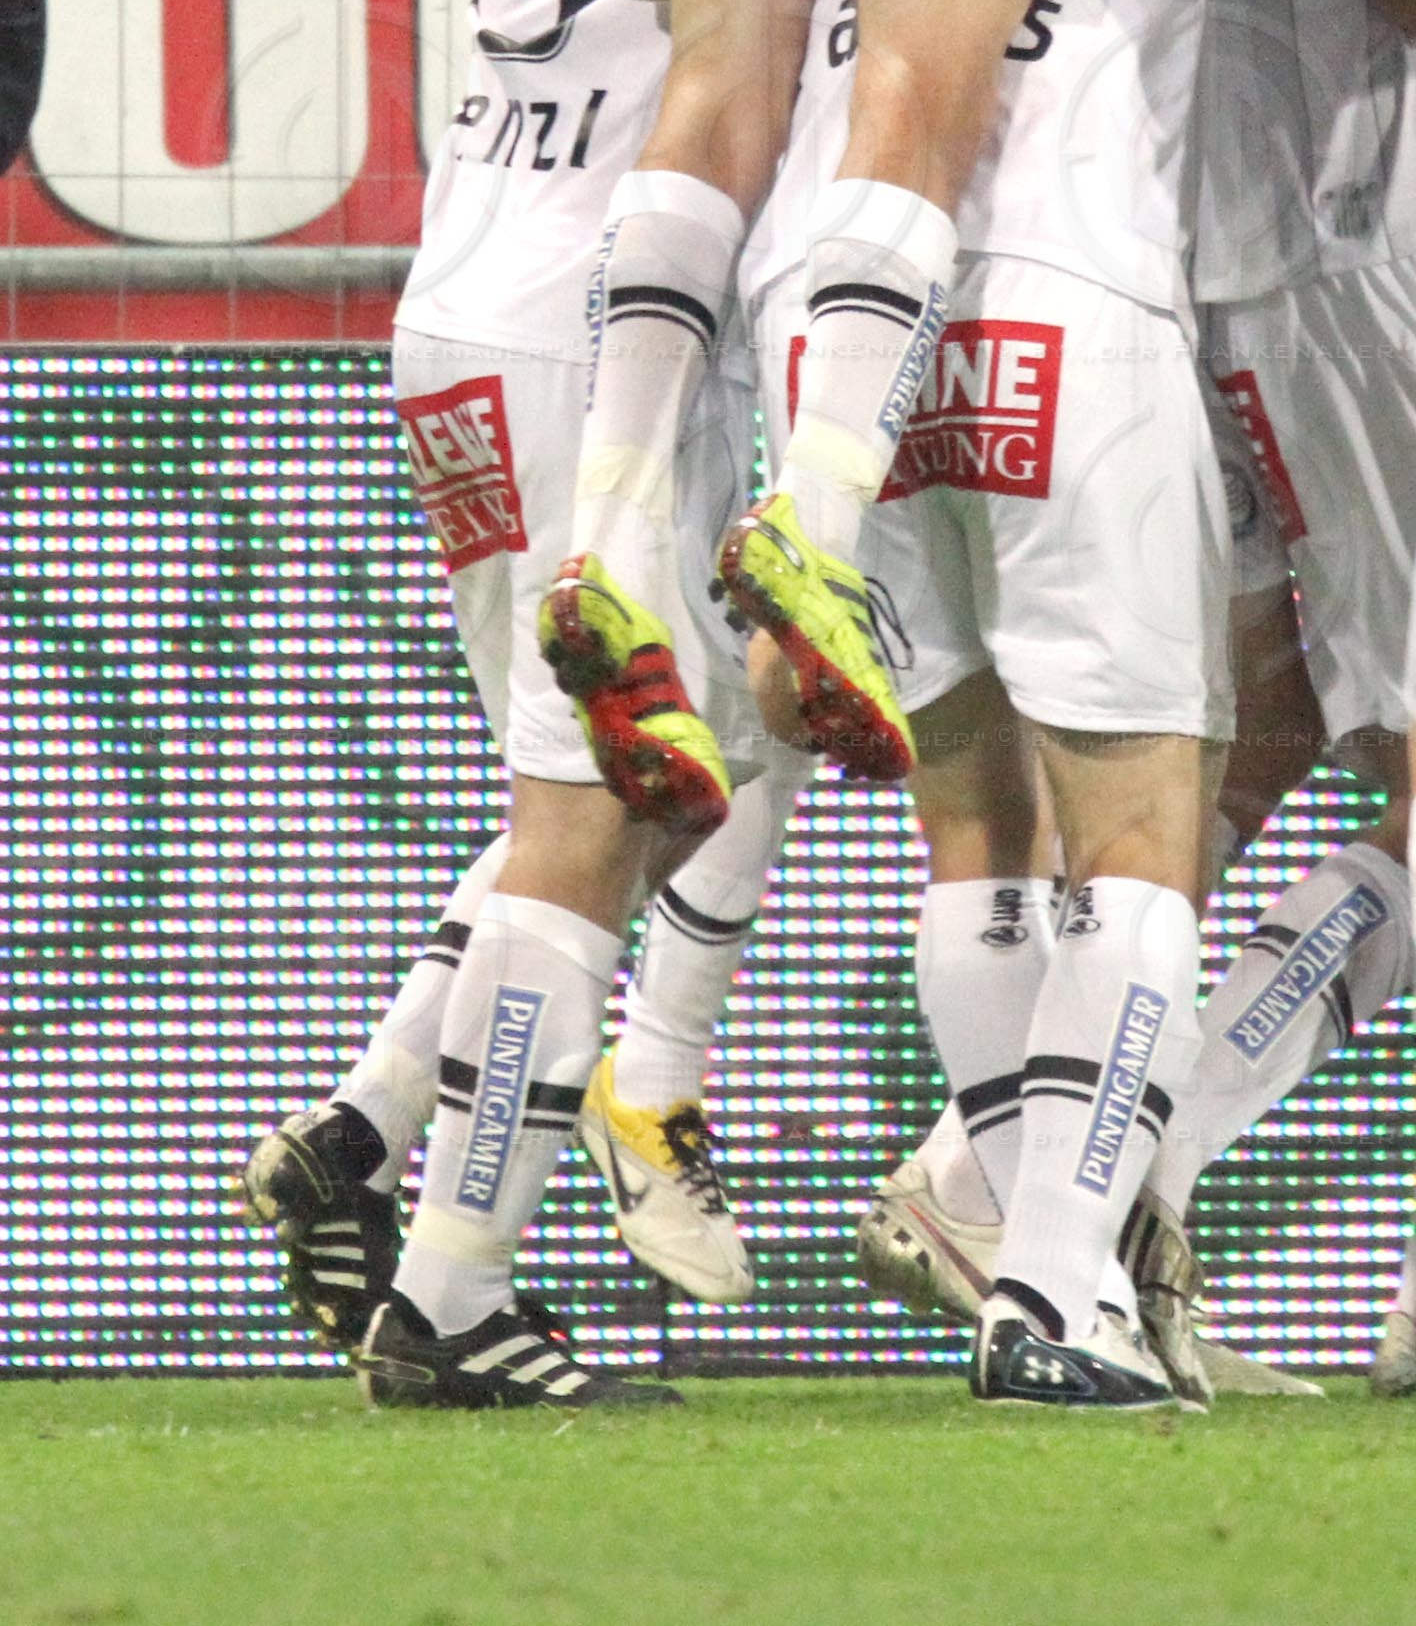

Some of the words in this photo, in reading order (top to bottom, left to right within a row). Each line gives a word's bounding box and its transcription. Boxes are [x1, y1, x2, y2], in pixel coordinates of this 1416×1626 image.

[1234, 891, 1386, 1050] PUNTIGAMER
[461, 998, 537, 1203] PUNTIGAMER
[1081, 993, 1163, 1187] PUNTIGAMER
